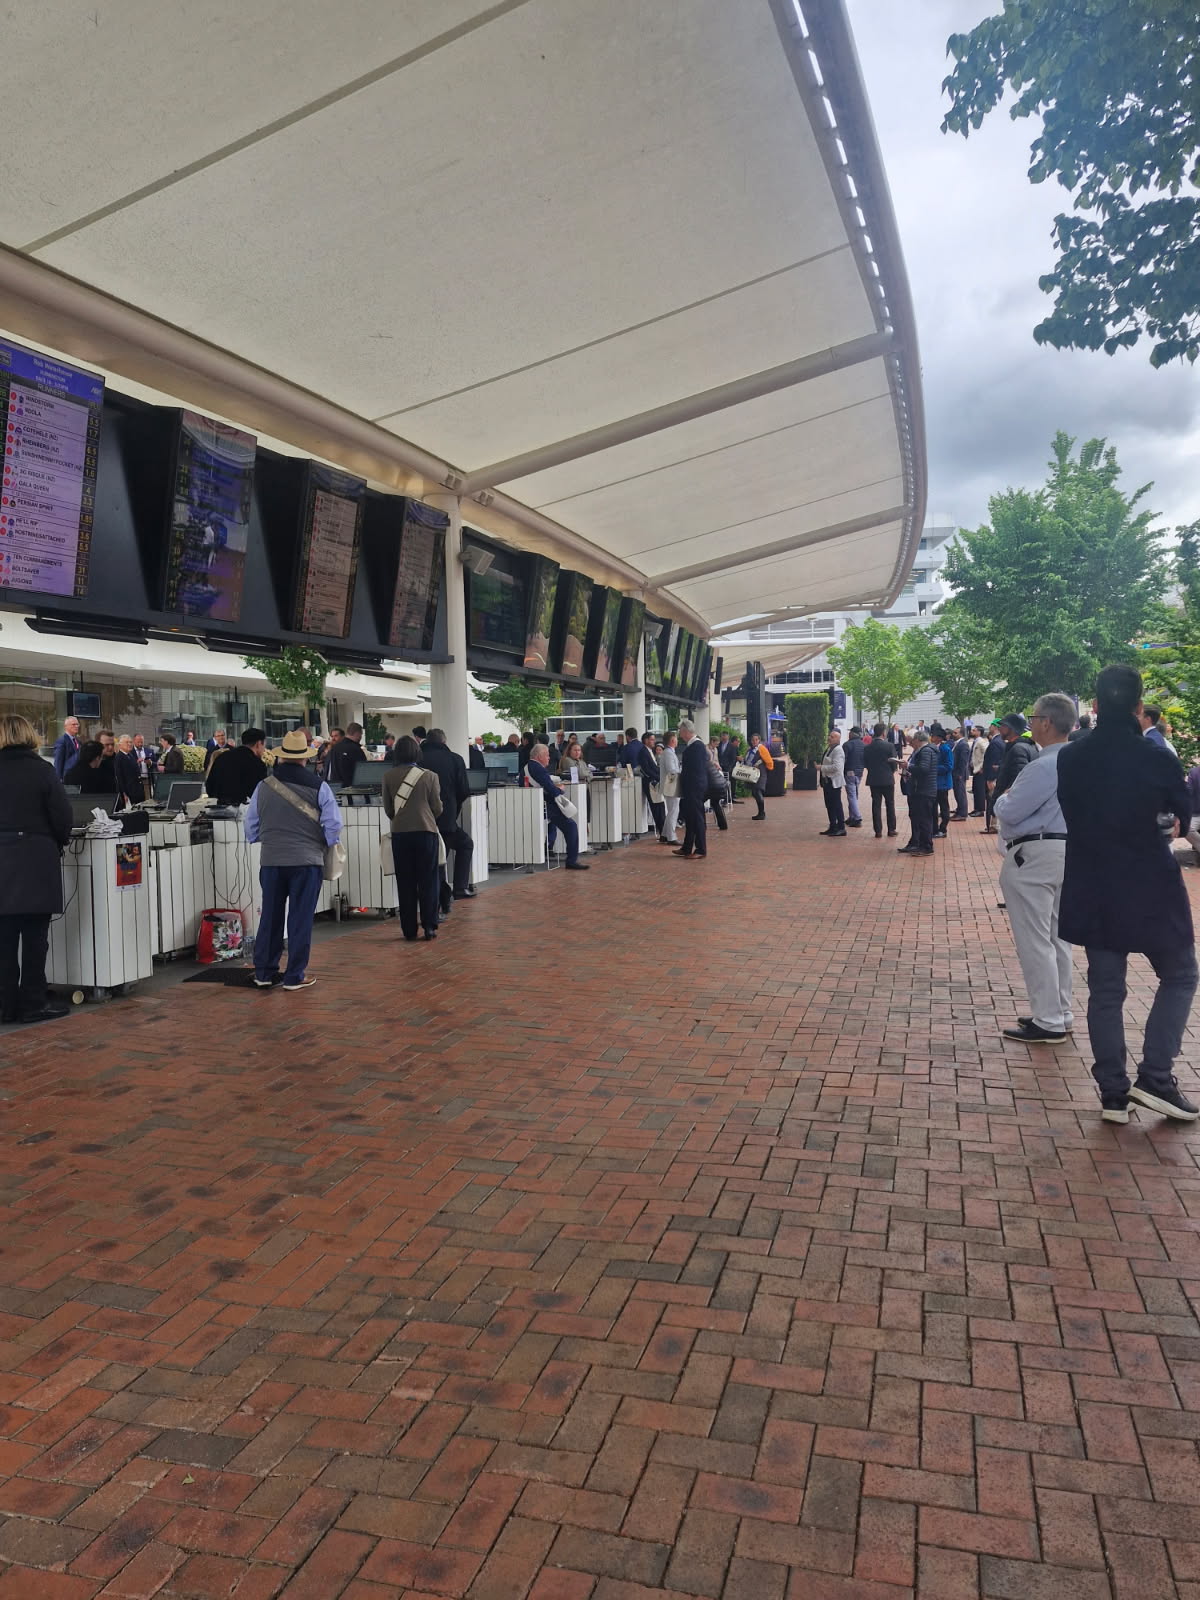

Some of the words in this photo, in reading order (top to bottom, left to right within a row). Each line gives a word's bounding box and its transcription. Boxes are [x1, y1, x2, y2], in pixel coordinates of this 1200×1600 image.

[38, 383, 66, 398] RUNNERS
[26, 396, 54, 408] WINDSTORM
[17, 499, 38, 507] PERSIAN
